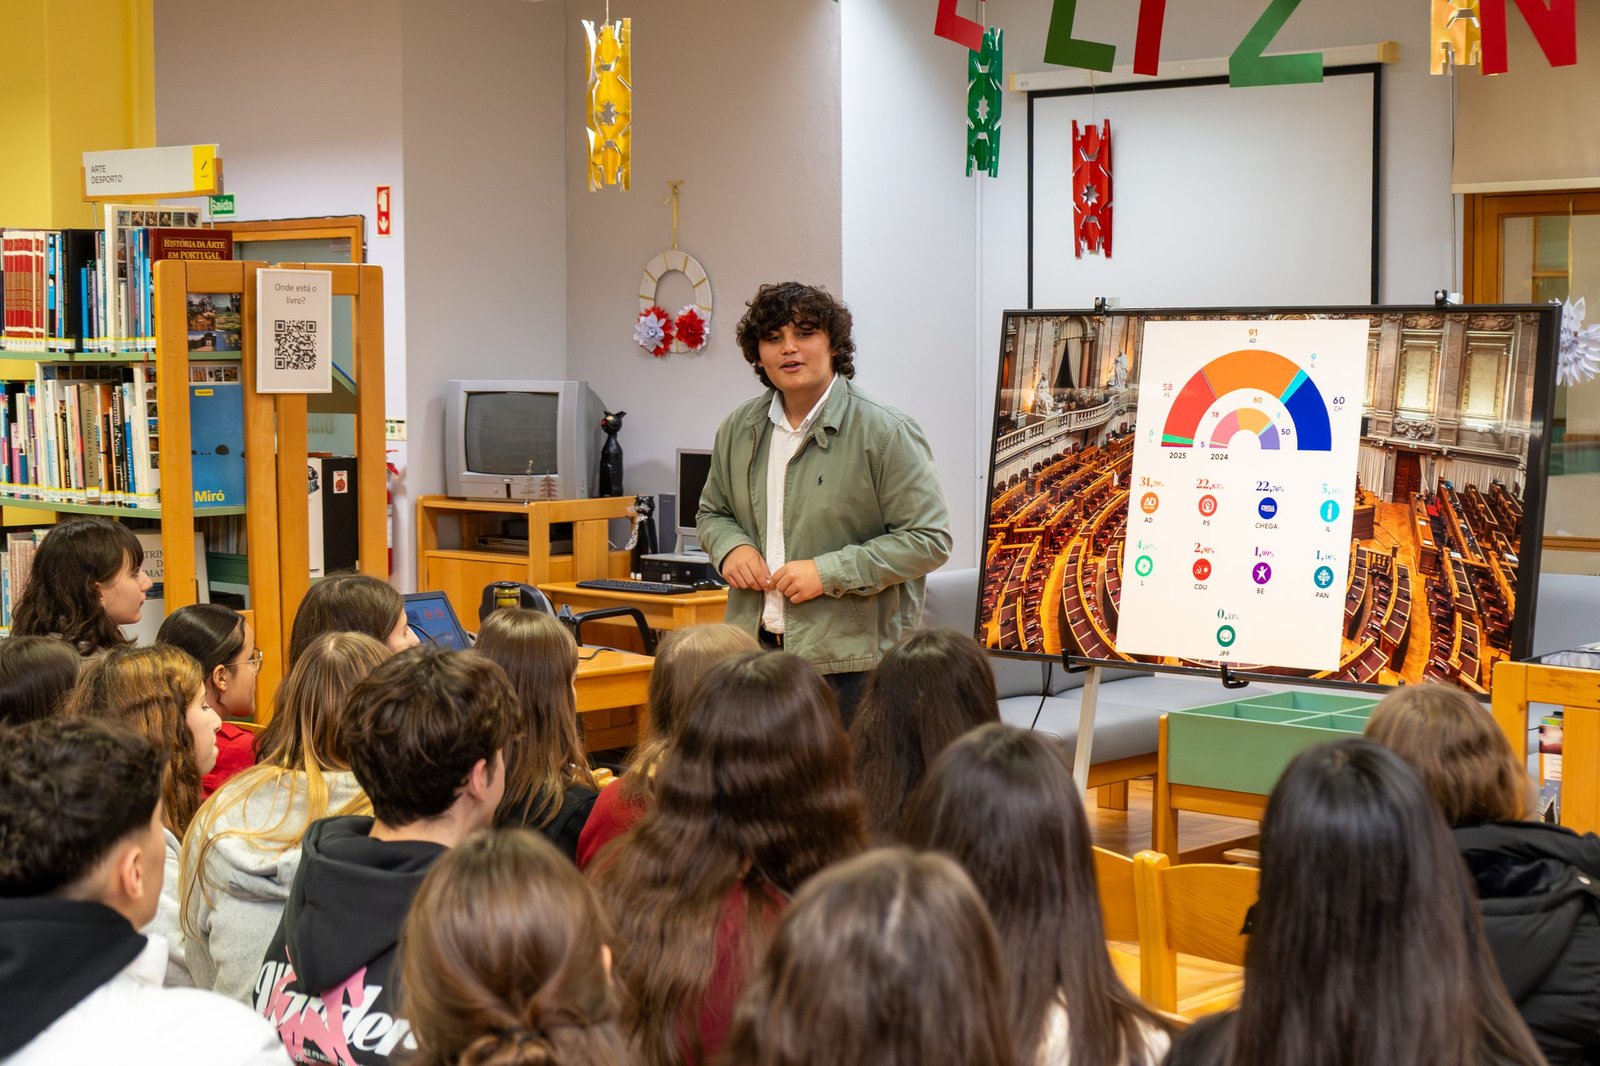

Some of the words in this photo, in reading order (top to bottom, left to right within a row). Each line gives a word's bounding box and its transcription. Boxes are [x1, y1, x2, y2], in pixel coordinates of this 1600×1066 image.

[90, 164, 106, 173] ARTE
[90, 174, 123, 185] DESPORTO
[206, 239, 226, 249] ARTE
[168, 251, 179, 259] EM
[180, 251, 222, 260] PORTUGAL
[274, 283, 295, 292] Onde
[295, 284, 311, 292] está
[286, 296, 306, 305] livro?
[1248, 328, 1258, 337] 91
[1162, 383, 1173, 391] 58
[1332, 396, 1345, 405] 60
[85, 409, 93, 445] HISTÓRIA
[1281, 428, 1291, 436] 50
[87, 447, 93, 458] DA
[194, 490, 225, 502] Miró
[1202, 519, 1211, 527] PS
[1255, 522, 1278, 530] CHEGA
[1256, 587, 1265, 595] BE
[1315, 591, 1329, 599] PAN
